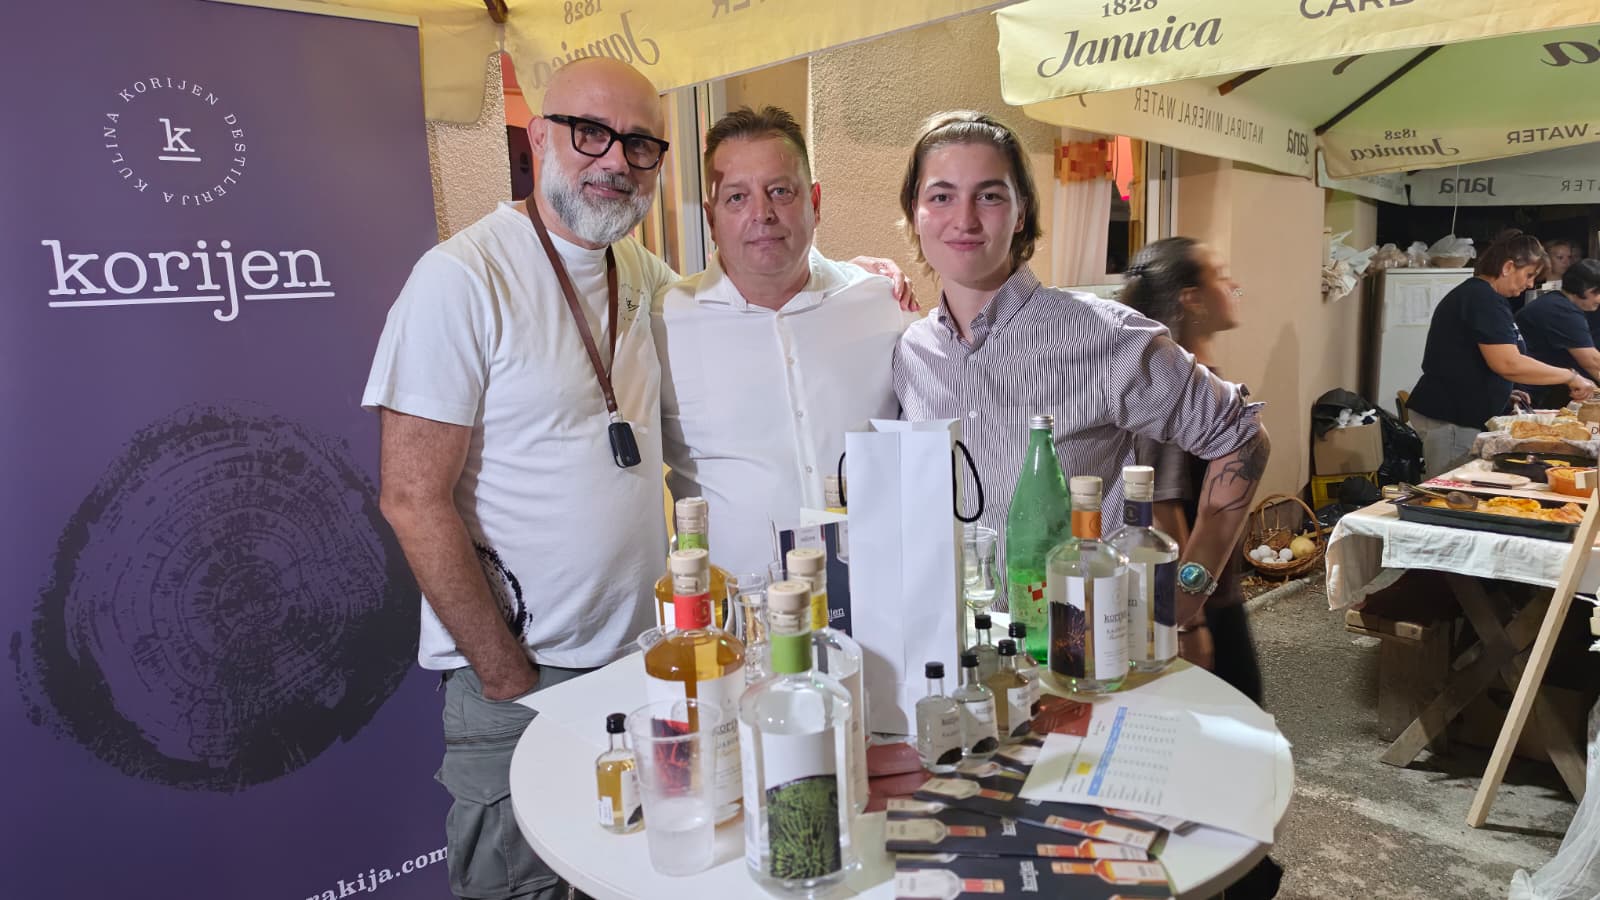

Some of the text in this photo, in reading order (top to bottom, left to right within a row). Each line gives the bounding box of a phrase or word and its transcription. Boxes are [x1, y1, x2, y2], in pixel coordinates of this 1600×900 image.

[1037, 15, 1222, 78] Jamnica
[103, 77, 246, 206] KORIJEN DESTILERIJA KULINA
[158, 118, 196, 153] k
[41, 239, 335, 322] korijen
